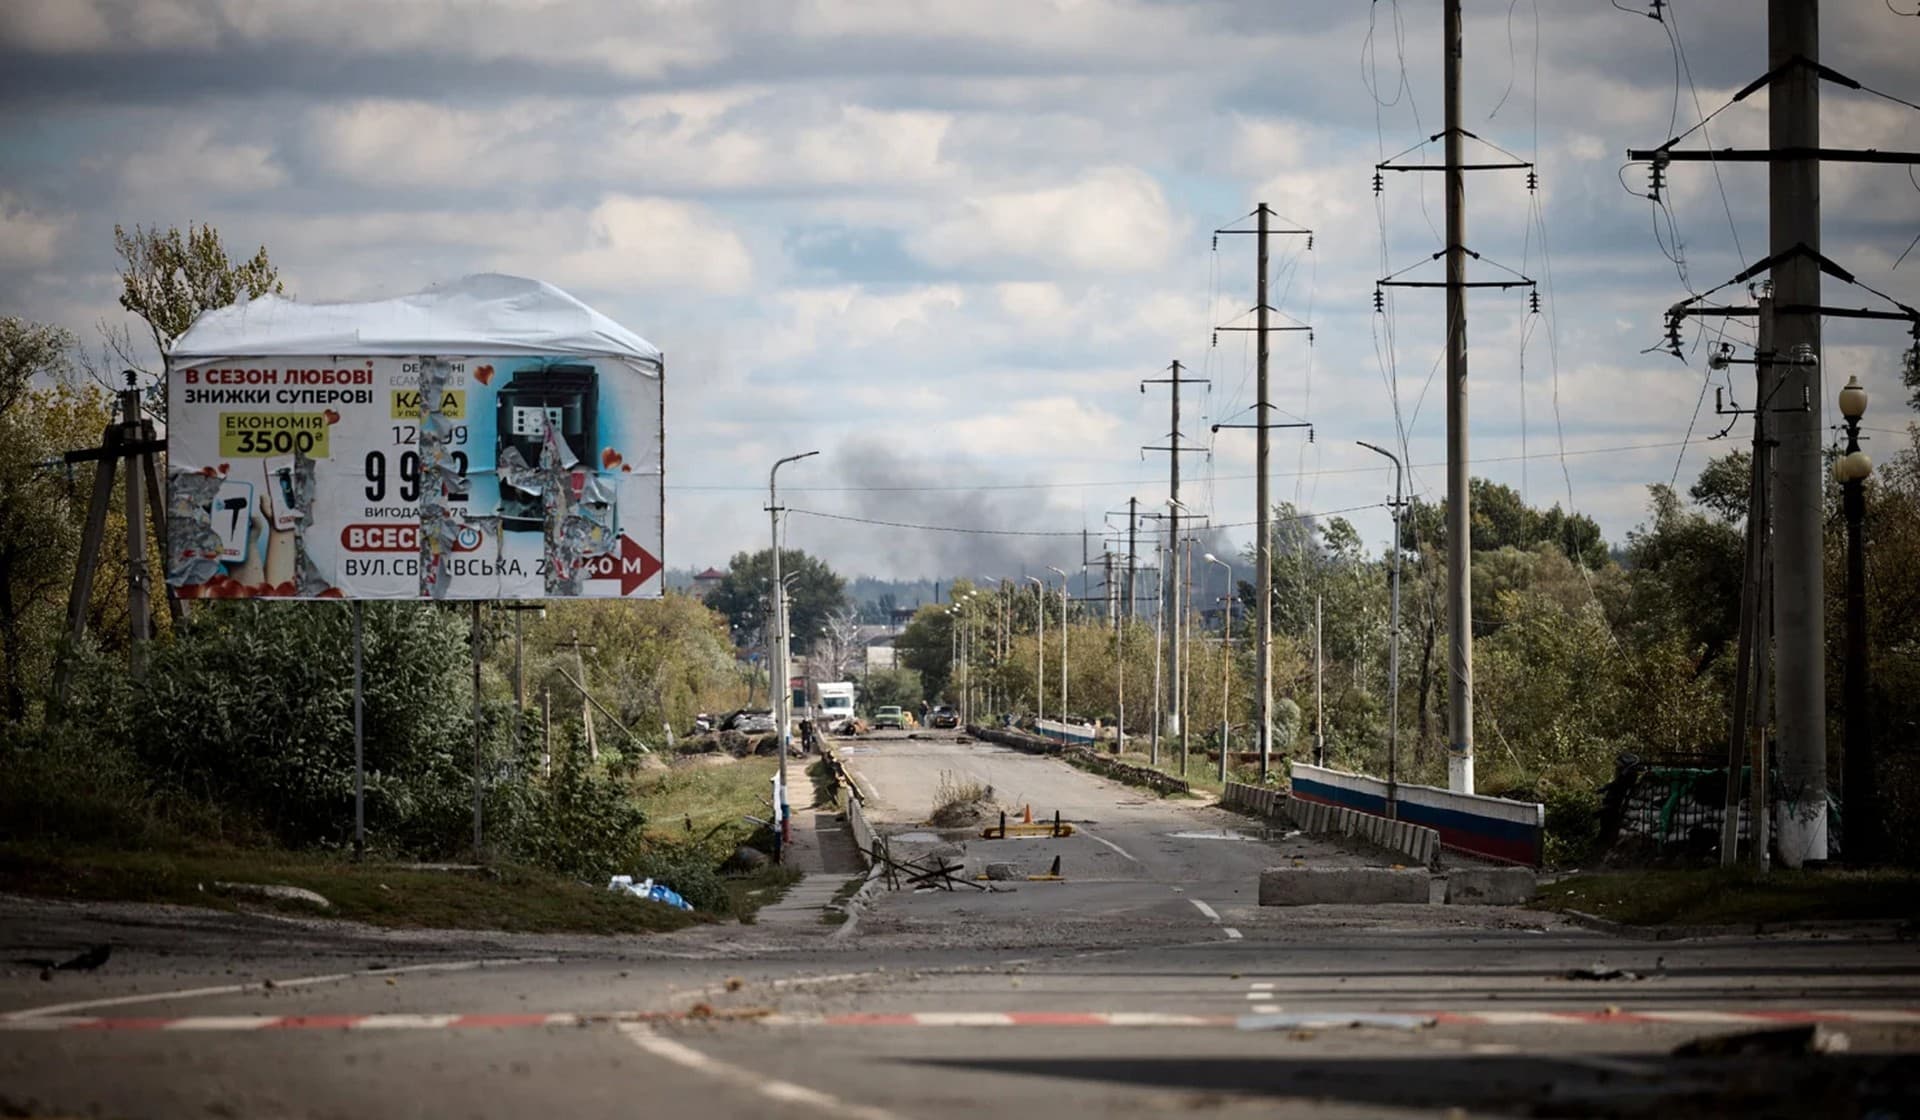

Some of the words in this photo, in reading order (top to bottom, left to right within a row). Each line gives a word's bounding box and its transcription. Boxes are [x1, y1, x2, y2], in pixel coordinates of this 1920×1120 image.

[185, 370, 199, 384] В
[205, 369, 277, 385] СЕЗОН
[184, 389, 271, 404] ЗНИЖКИ
[276, 389, 373, 404] СУПЕРОВІ
[396, 392, 458, 408] КАА
[226, 417, 323, 429] ЕКОНОМІЯ
[365, 507, 420, 518] ВИГОДА
